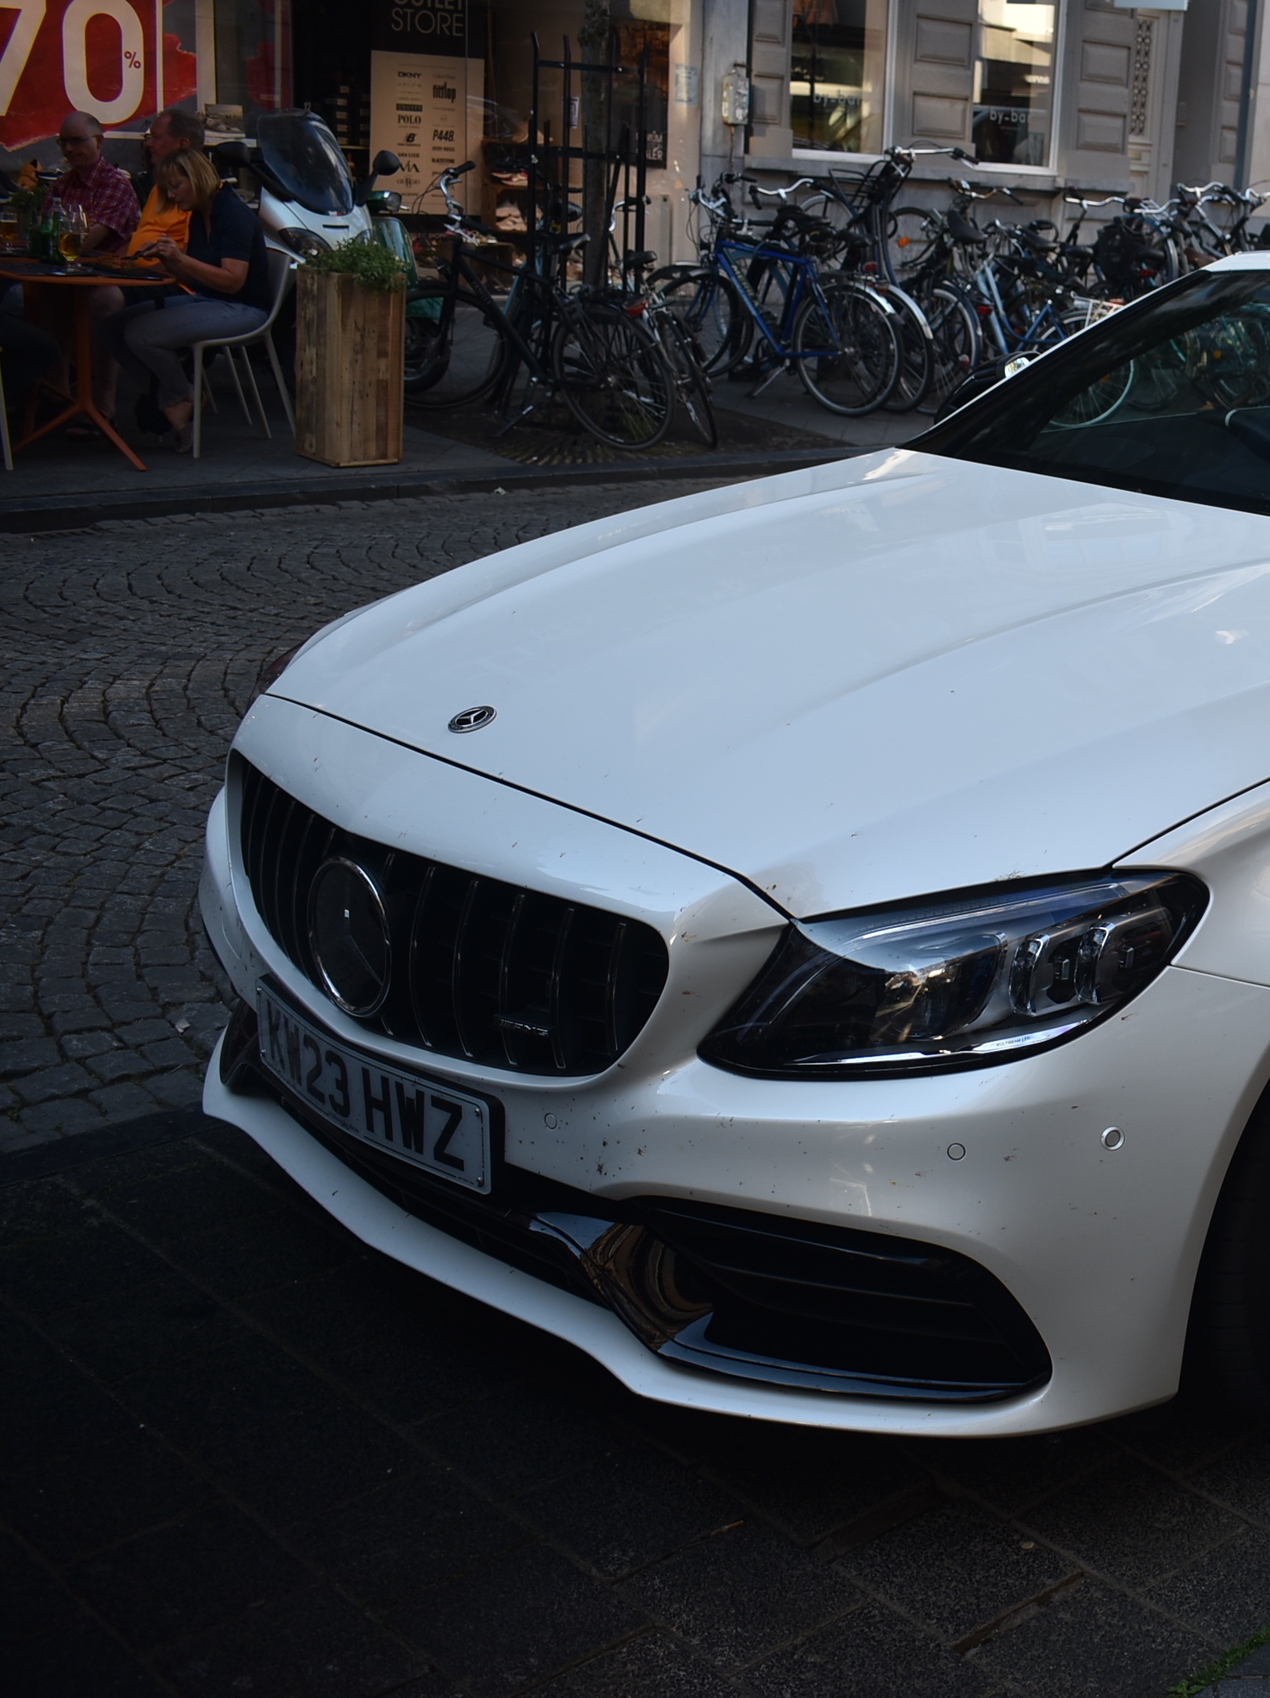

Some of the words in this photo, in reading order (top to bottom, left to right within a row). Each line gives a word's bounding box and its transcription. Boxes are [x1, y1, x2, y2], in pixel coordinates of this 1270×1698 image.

[391, 7, 464, 37] STORE
[398, 71, 422, 79] DKNY
[398, 114, 422, 125] POLO
[268, 1001, 351, 1117] KW23
[362, 1069, 465, 1171] HWZ
